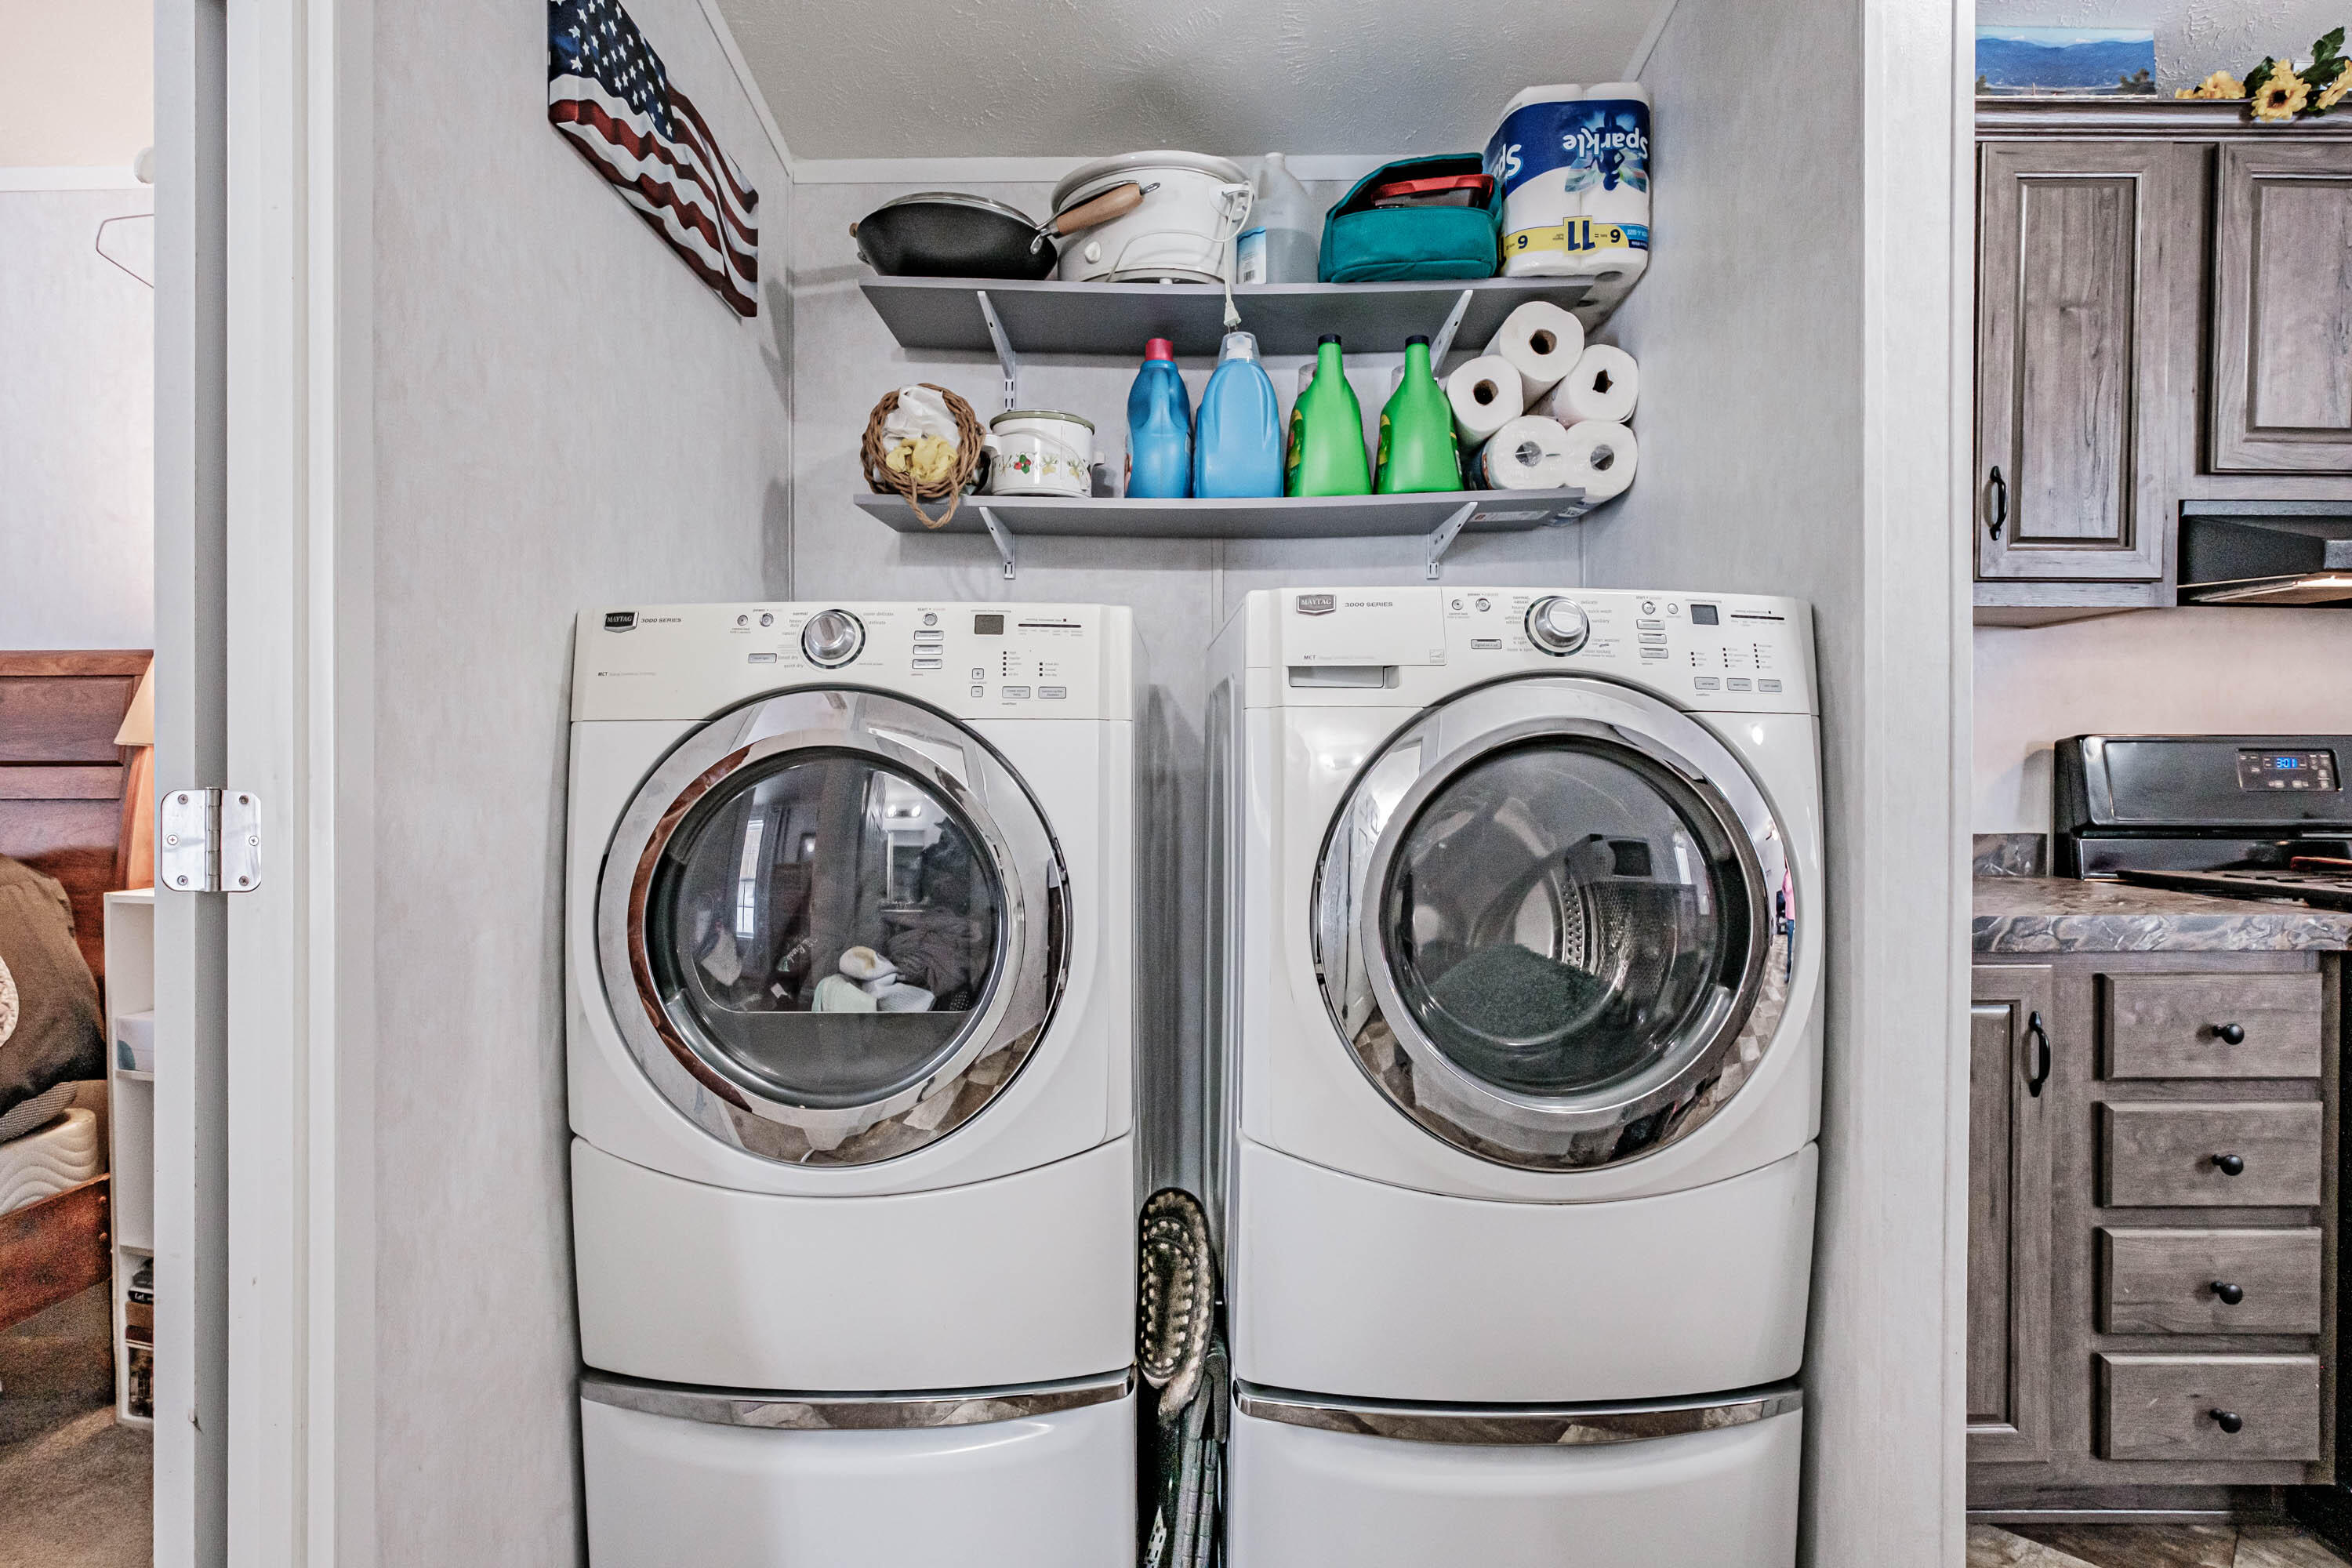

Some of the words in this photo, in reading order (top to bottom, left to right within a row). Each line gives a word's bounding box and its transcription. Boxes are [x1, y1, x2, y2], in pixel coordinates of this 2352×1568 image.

[1563, 127, 1649, 160] Sparkle
[1517, 235, 1529, 249] 6
[1567, 220, 1595, 252] 11
[1610, 229, 1621, 244] 6
[1301, 597, 1332, 606] MAYTAG
